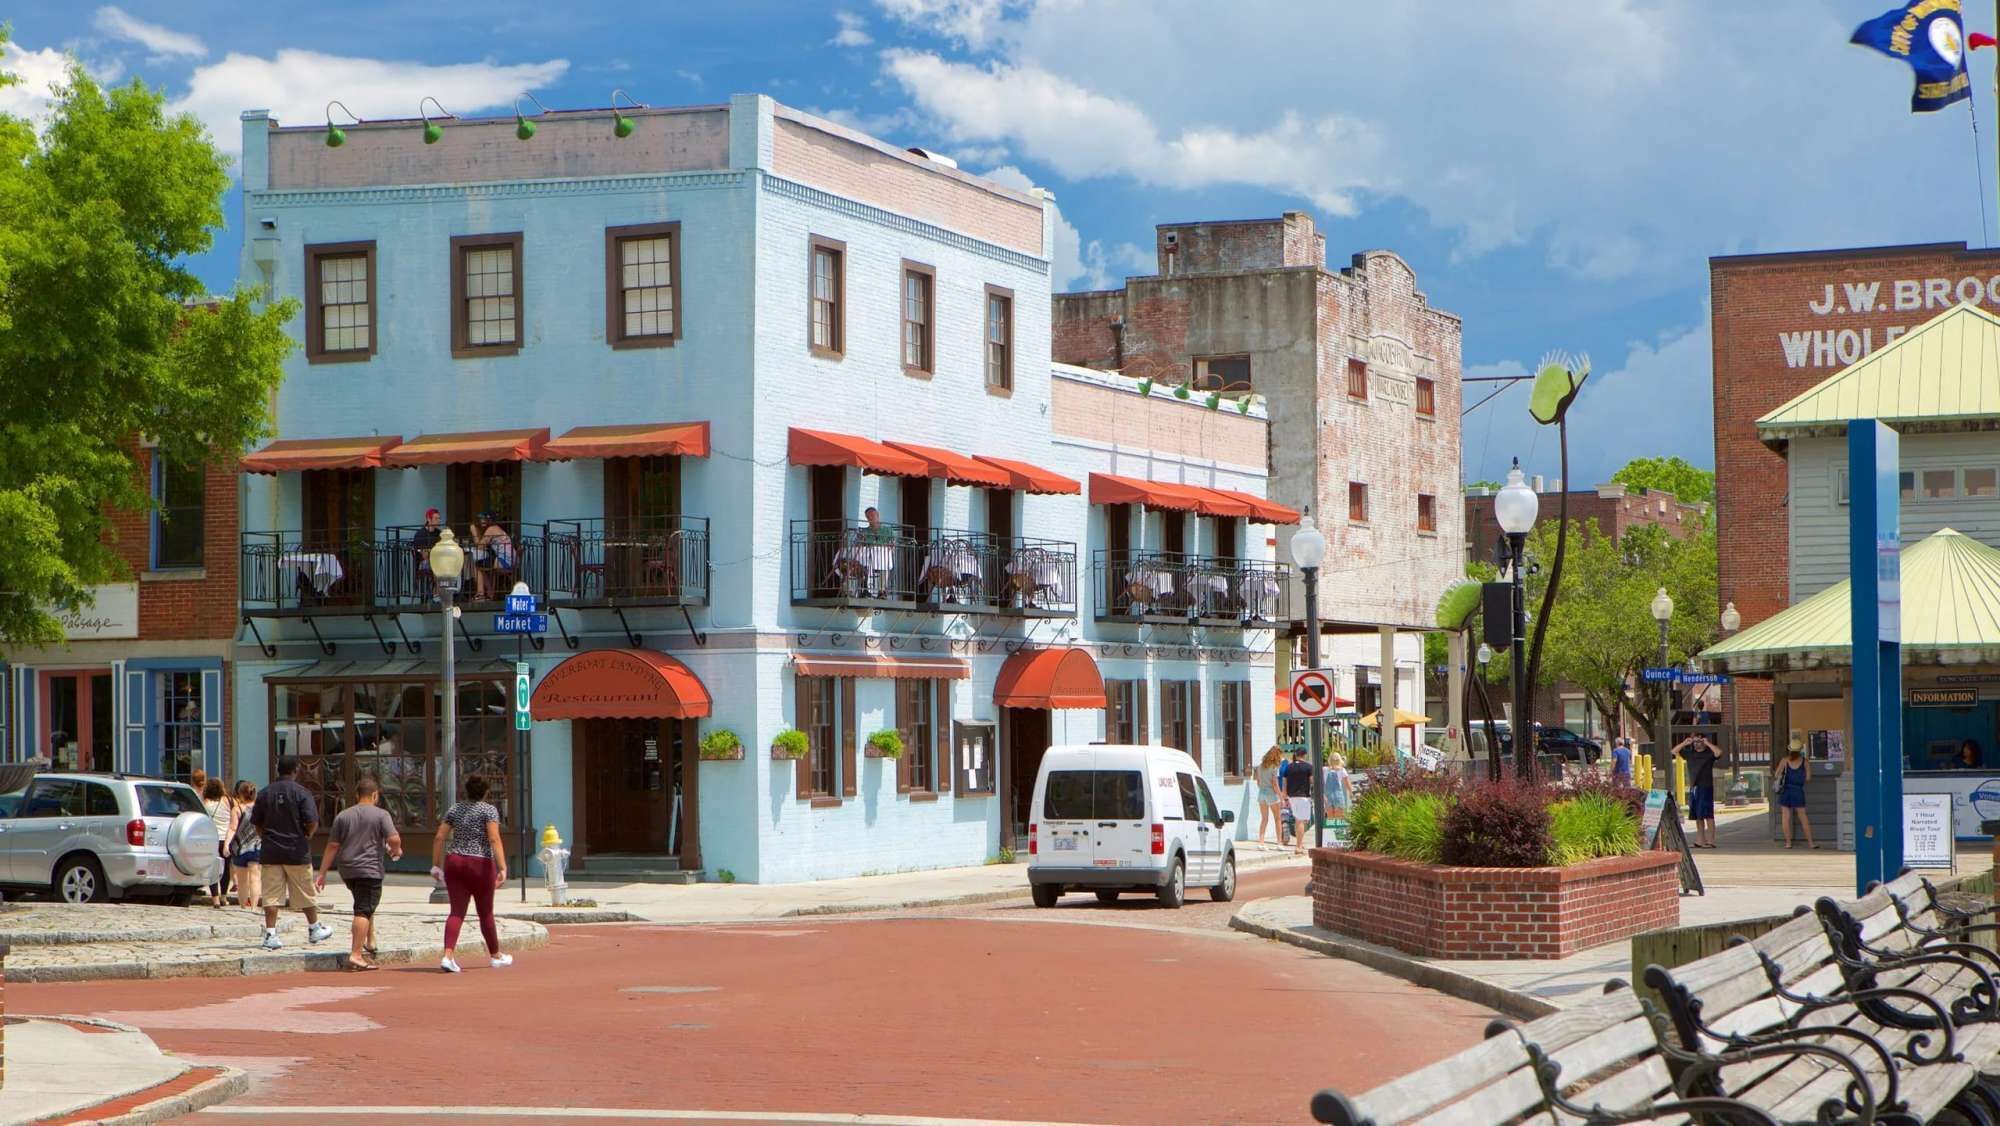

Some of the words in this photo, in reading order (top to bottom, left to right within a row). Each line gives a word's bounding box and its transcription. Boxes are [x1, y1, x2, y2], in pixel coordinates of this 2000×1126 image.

[1808, 282, 1887, 316] J.W.
[512, 597, 529, 612] Water
[497, 616, 531, 631] Market
[609, 658, 664, 690] LANDING
[1645, 670, 1671, 679] Quince
[1683, 675, 1718, 683] Henderson
[542, 693, 659, 705] Restaurant
[1912, 692, 1975, 703] INFORMATION
